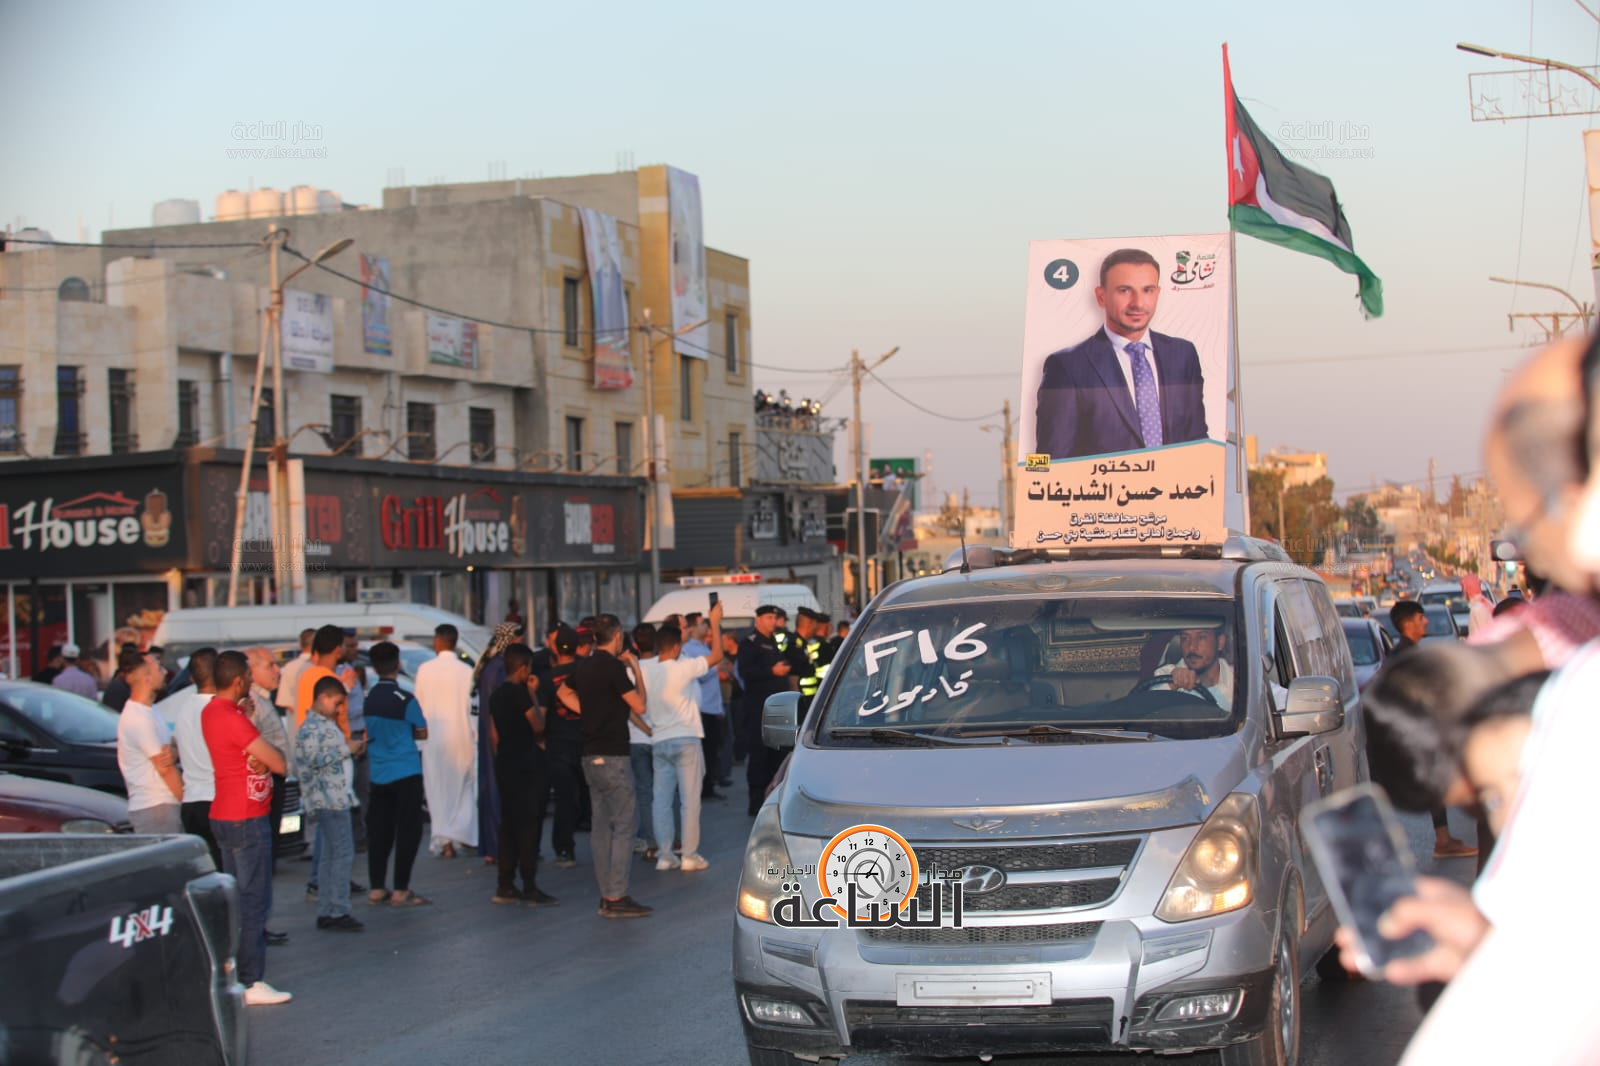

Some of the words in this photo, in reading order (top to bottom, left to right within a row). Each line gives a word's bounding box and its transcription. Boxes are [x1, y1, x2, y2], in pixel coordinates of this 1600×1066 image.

[1052, 265, 1071, 282] 4
[1090, 460, 1155, 475] الدكتور
[1028, 479, 1112, 507] الشديفات
[1116, 484, 1163, 506] حسن
[1169, 475, 1215, 500] أحمد
[13, 498, 140, 551] House
[381, 495, 443, 549] Grill
[444, 493, 508, 557] House
[1069, 512, 1096, 526] المفرق
[1098, 512, 1137, 524] محافظة
[1139, 512, 1167, 526] مرشح
[1036, 530, 1062, 543] حسن
[864, 622, 988, 677] F16
